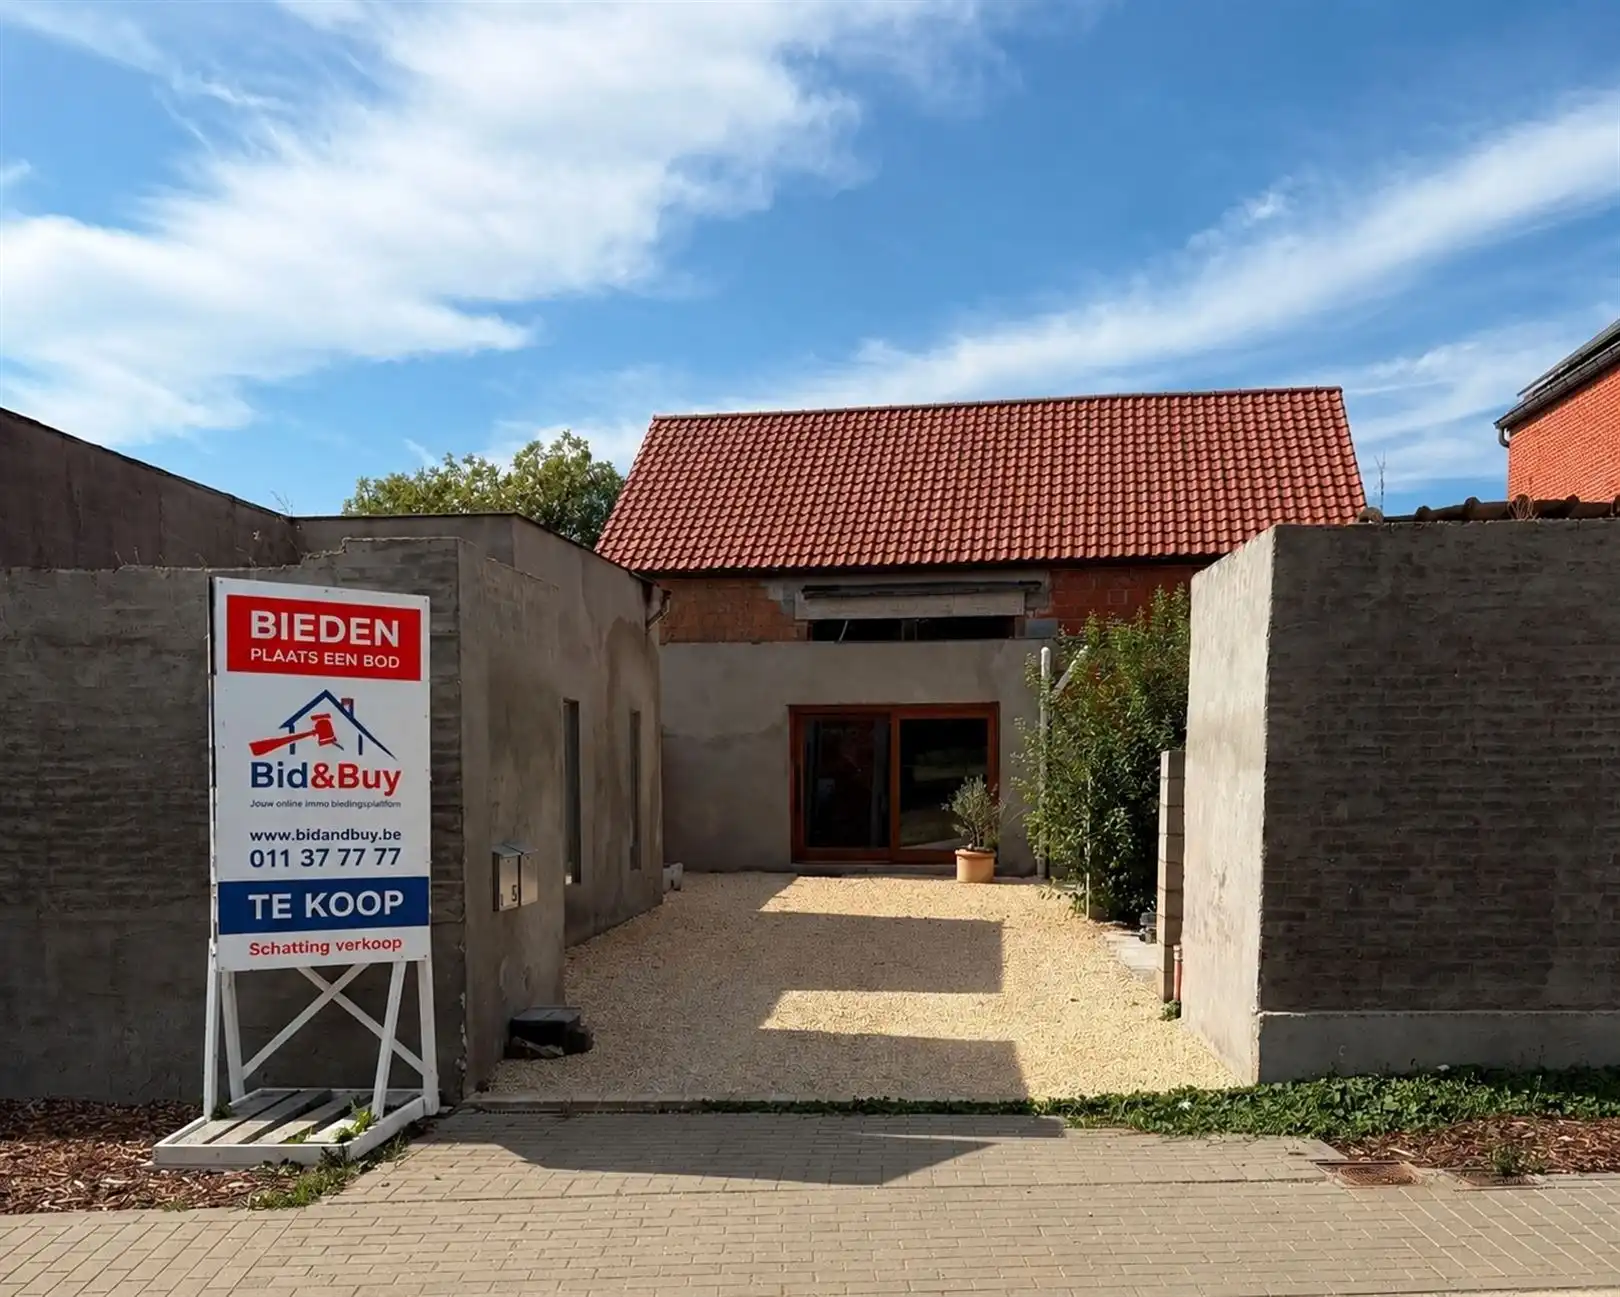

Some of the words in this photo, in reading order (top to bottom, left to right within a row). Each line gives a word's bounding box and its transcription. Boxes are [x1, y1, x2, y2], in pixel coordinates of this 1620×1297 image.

[250, 610, 399, 647] BIEDEN
[250, 648, 318, 664] PLAATS
[324, 652, 357, 666] EEN
[363, 655, 400, 669] BOD
[250, 761, 402, 796] Bid&Buy
[250, 800, 274, 808] Jouw
[276, 799, 303, 808] online
[250, 829, 401, 843] www.bidandbuy.be
[250, 849, 289, 868] 011
[300, 849, 330, 867] 37
[337, 848, 366, 866] 77
[373, 847, 402, 865] 77
[248, 893, 292, 920] TE
[305, 890, 404, 918] KOOP
[249, 940, 330, 956] Schatting
[336, 937, 402, 952] verkoop
